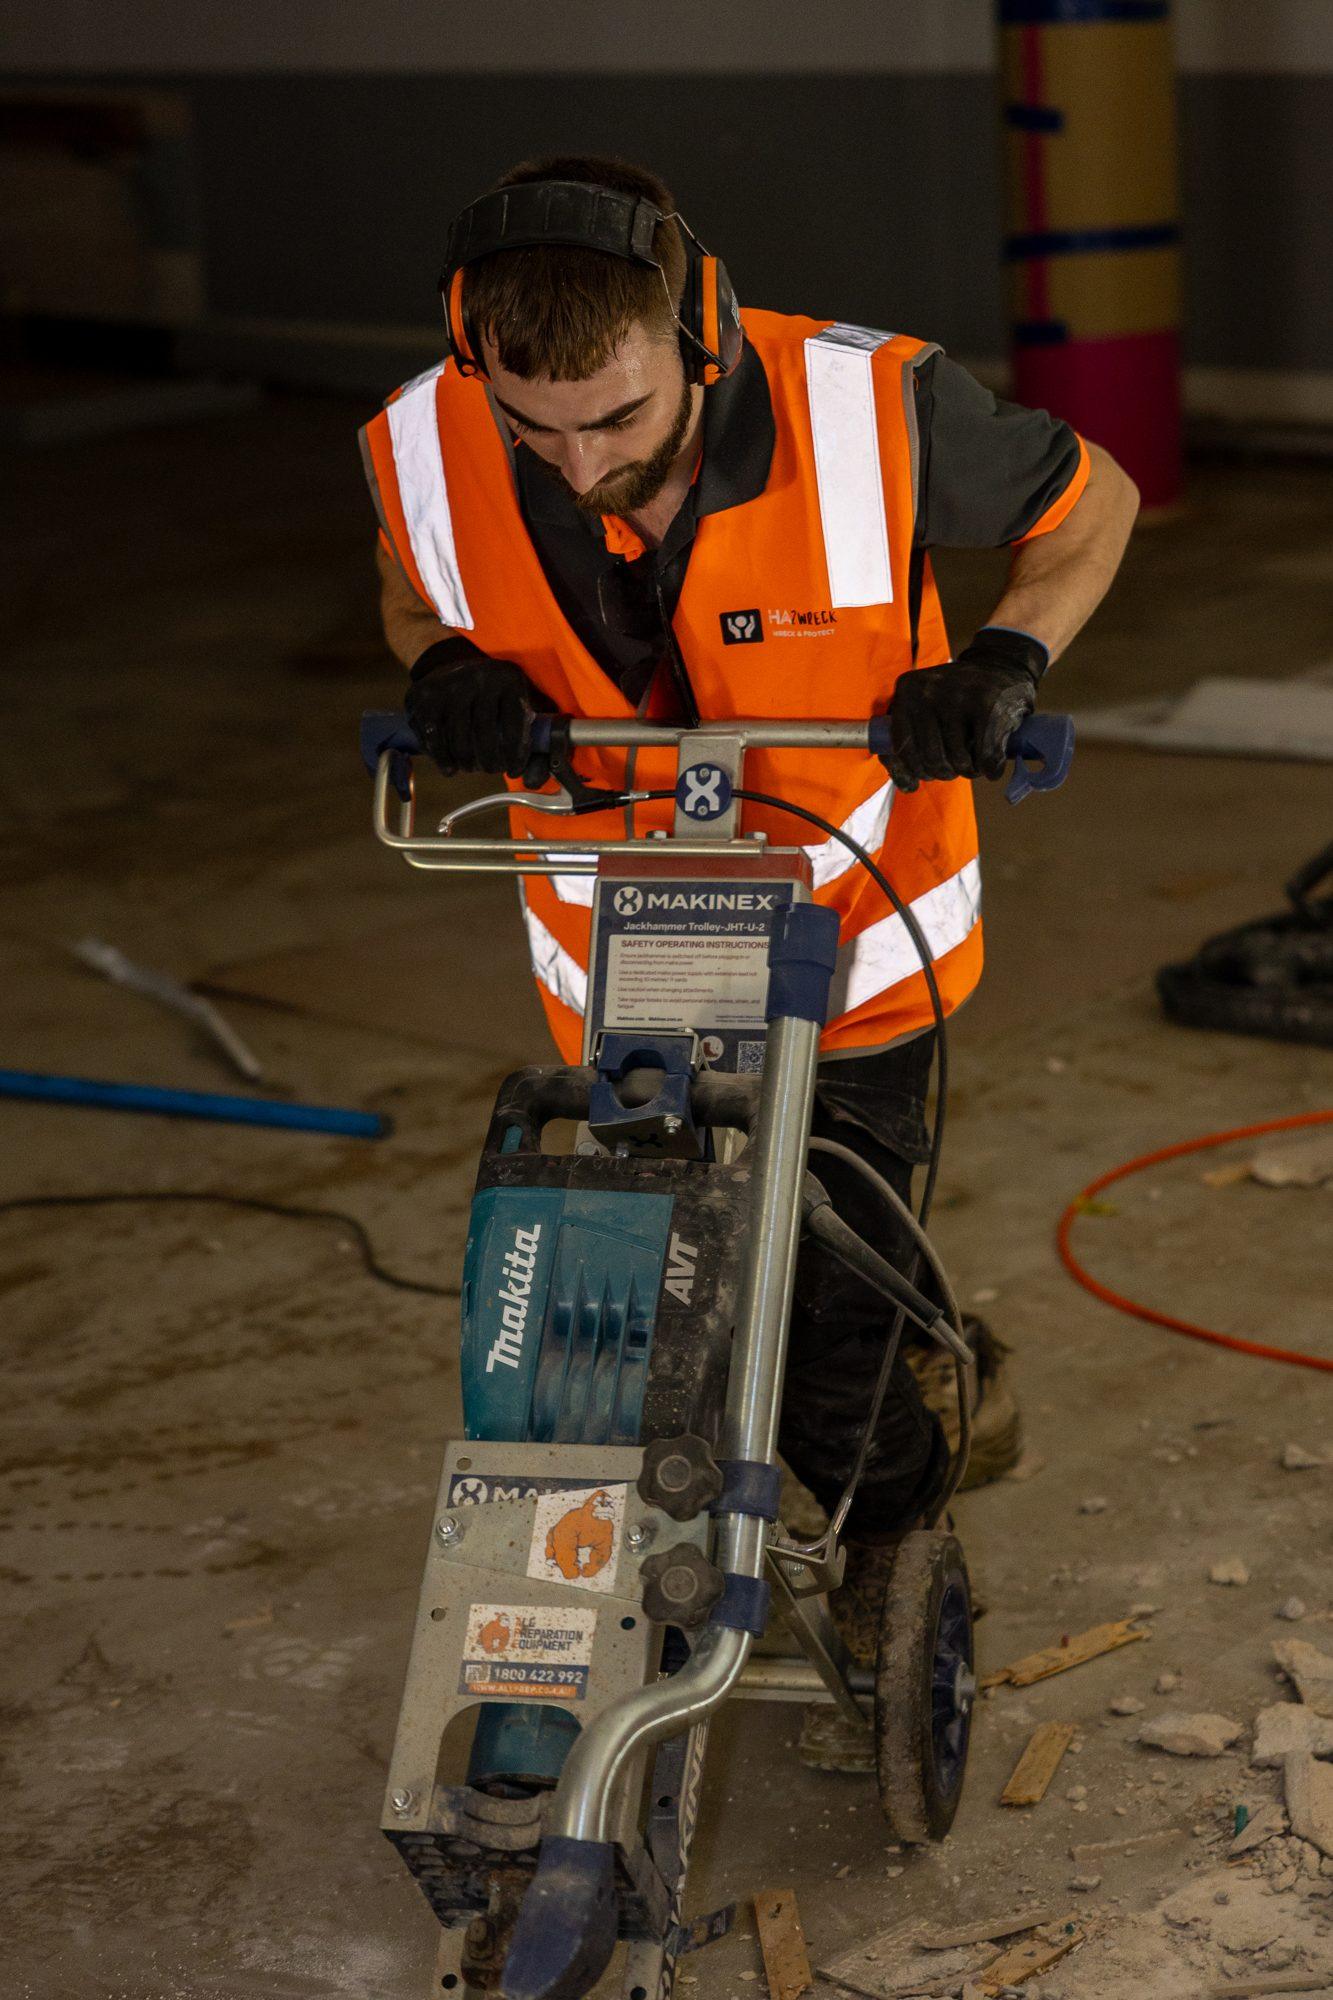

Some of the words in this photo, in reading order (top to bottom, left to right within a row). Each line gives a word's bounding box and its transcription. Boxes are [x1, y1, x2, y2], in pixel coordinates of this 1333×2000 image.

[803, 628, 835, 638] PROTECT
[647, 893, 774, 911] MAKINEX
[623, 921, 686, 932] Jackhammer
[621, 940, 655, 948] SAFETY
[656, 940, 705, 949] OPERATING
[706, 940, 769, 950] INSTRUCTIONS
[663, 1232, 698, 1306] AVT
[513, 1627, 584, 1641] PREPARATION
[510, 1638, 573, 1652] EQUIPMENT
[494, 1668, 526, 1681] 1800
[529, 1669, 554, 1682] 422
[558, 1670, 584, 1684] 992
